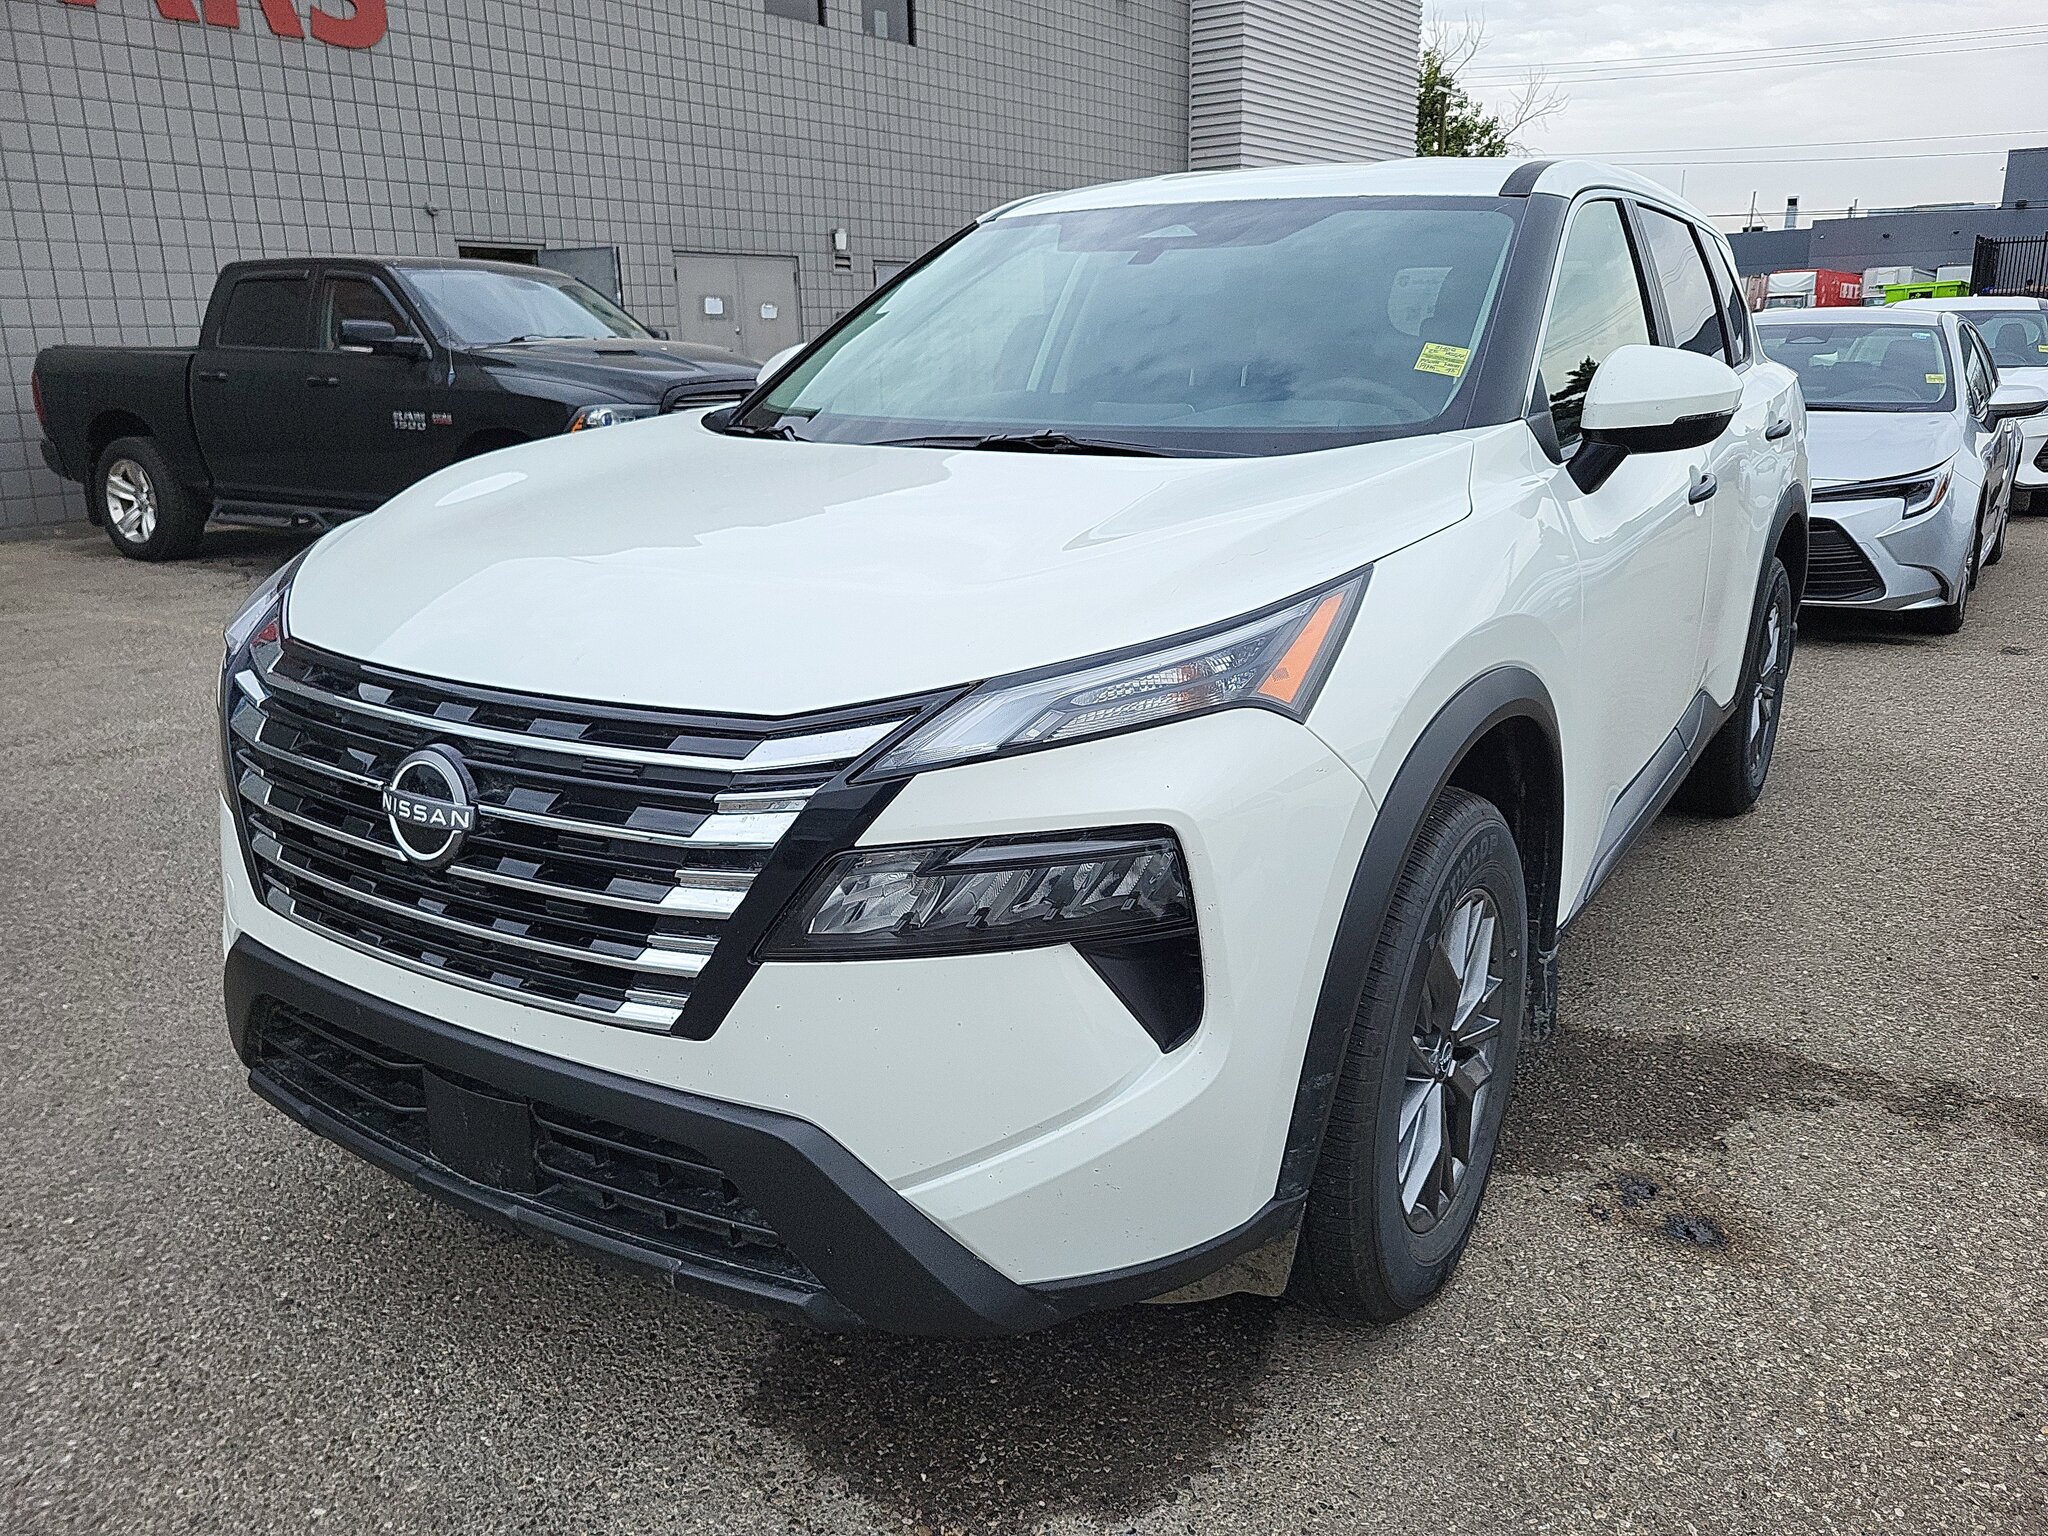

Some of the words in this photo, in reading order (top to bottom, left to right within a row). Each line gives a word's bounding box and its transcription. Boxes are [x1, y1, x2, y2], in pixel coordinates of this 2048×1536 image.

[393, 410, 425, 420] RAM
[393, 421, 426, 430] 1500
[382, 791, 469, 828] NISSAN
[1440, 834, 1499, 924] DUNLOP
